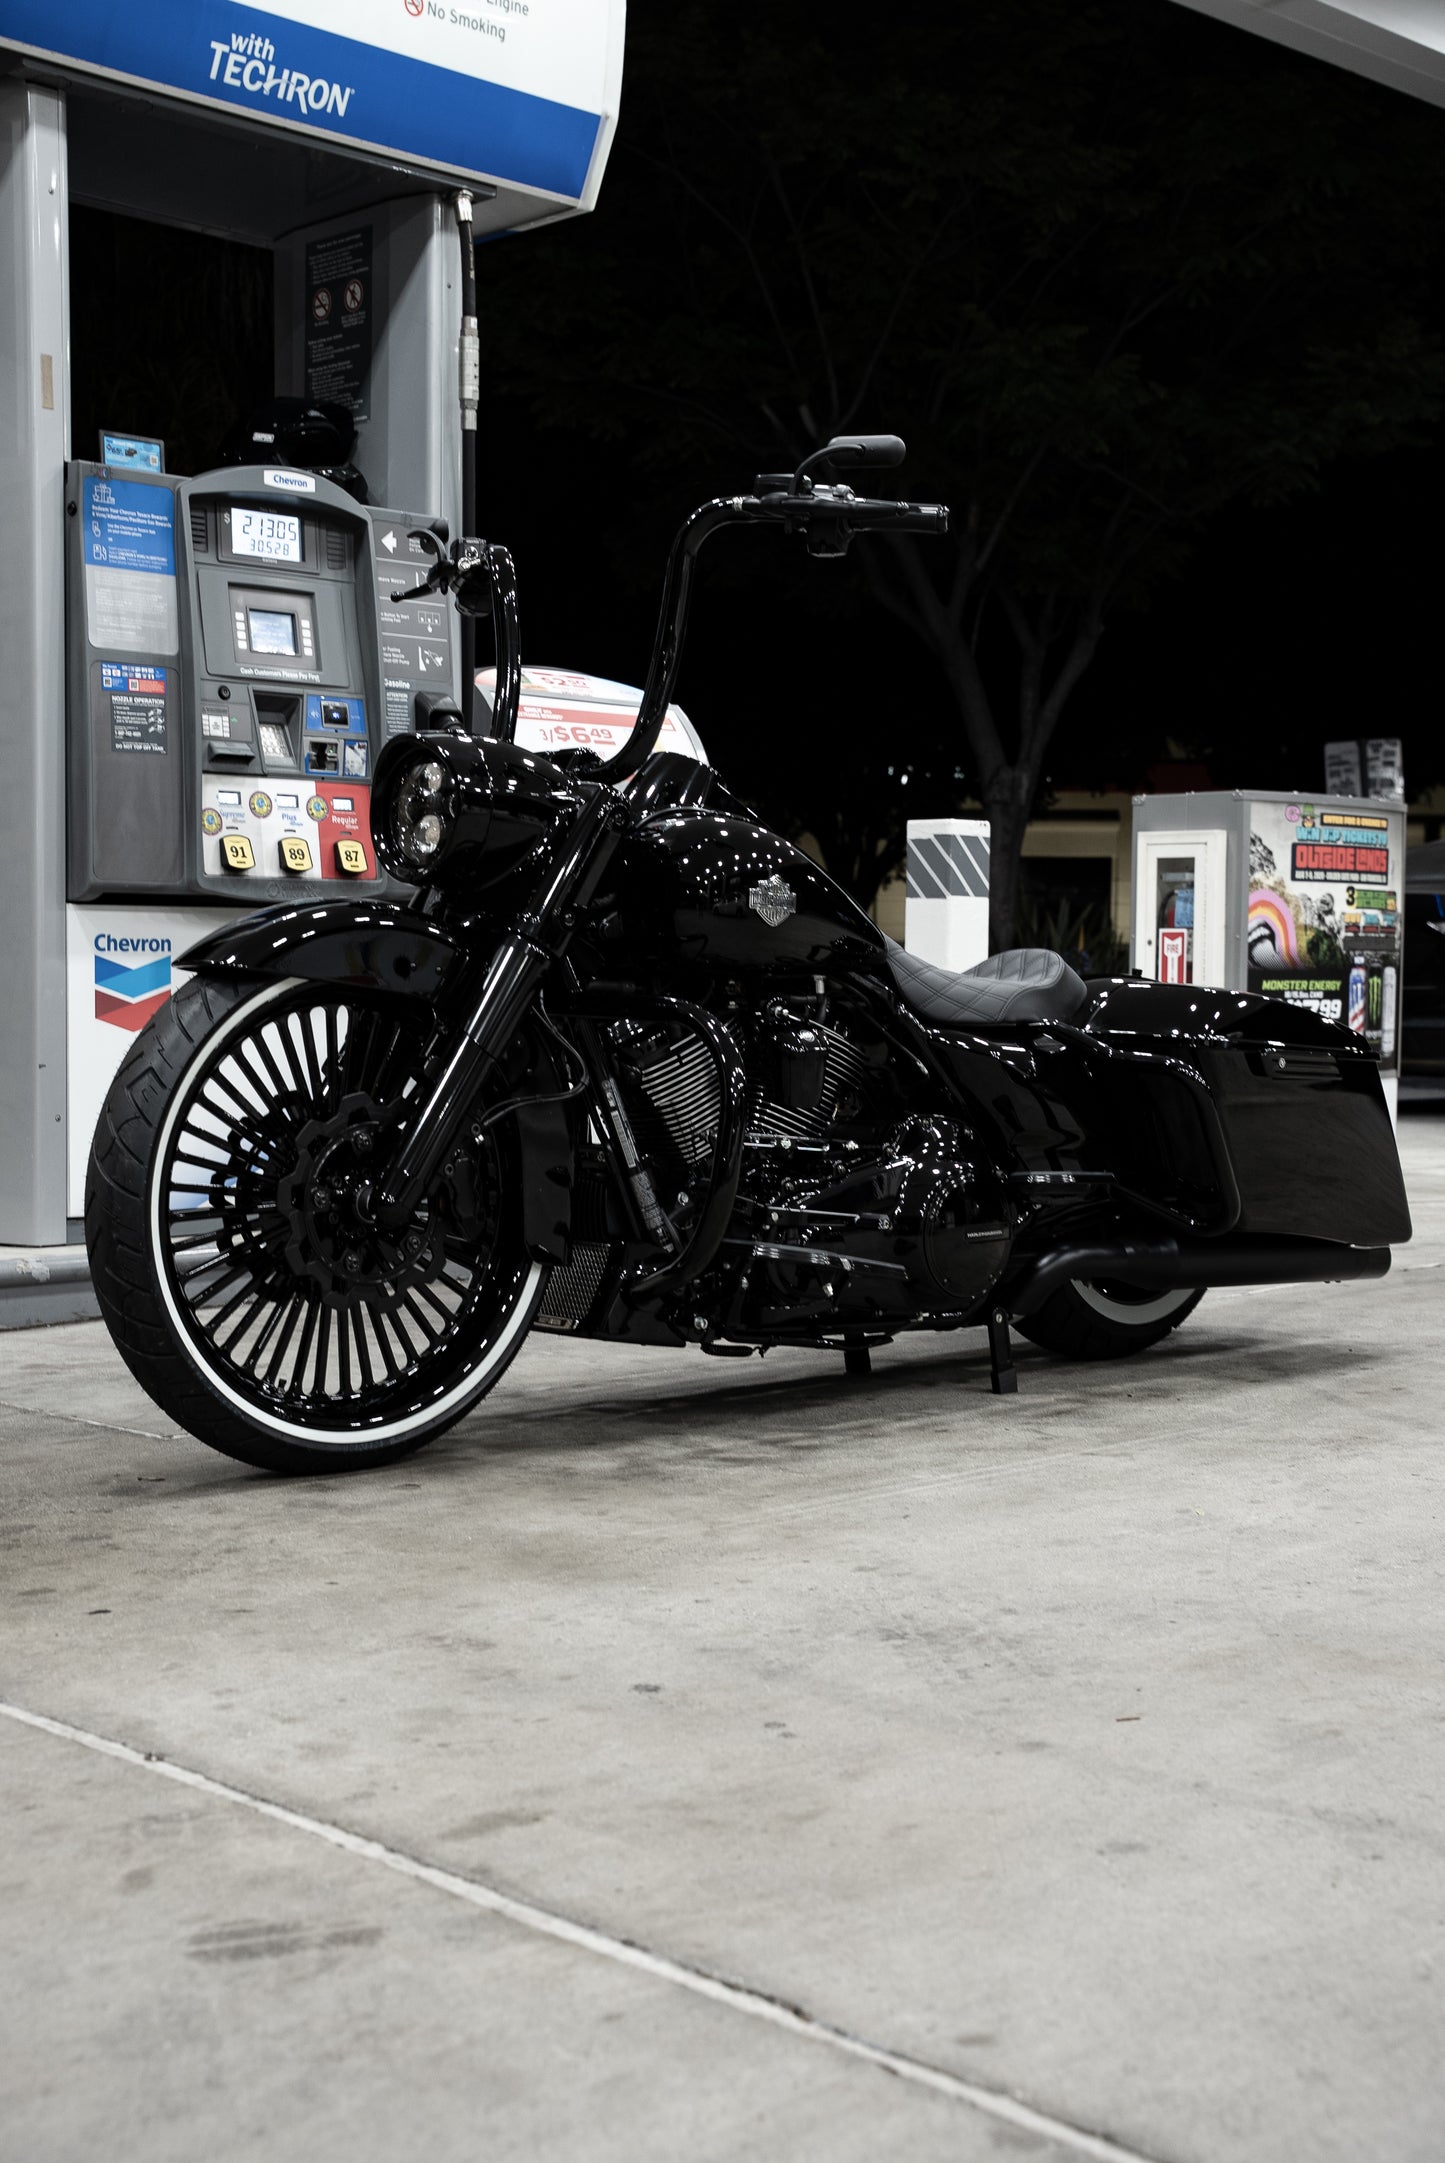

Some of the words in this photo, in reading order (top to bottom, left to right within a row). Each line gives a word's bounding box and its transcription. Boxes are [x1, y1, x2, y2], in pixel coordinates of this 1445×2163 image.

[486, 0, 529, 16] ngine
[427, 1, 446, 20] No
[450, 9, 506, 43] Smoking
[231, 32, 275, 62] with
[209, 41, 351, 117] TECHRON
[273, 474, 308, 488] Chevron
[240, 667, 254, 675] Cash
[254, 668, 282, 678] Customers
[282, 670, 299, 679] Please
[111, 695, 133, 704] NOZZLE
[134, 697, 165, 706] OPERATION
[281, 813, 297, 821] Plus
[331, 815, 359, 826] Regular
[1296, 826, 1321, 842] WIN
[1323, 828, 1341, 843] VIP
[1341, 829, 1378, 846] TICKETS
[230, 845, 248, 860] 91
[289, 848, 306, 861] 89
[344, 850, 359, 863] 87
[1296, 844, 1356, 871] OUTSIDE
[1356, 847, 1388, 873] LANDS
[1346, 886, 1356, 906] 3
[94, 934, 172, 952] Chevron
[1262, 980, 1308, 991] MONSTER
[1309, 980, 1342, 992] ENERGY
